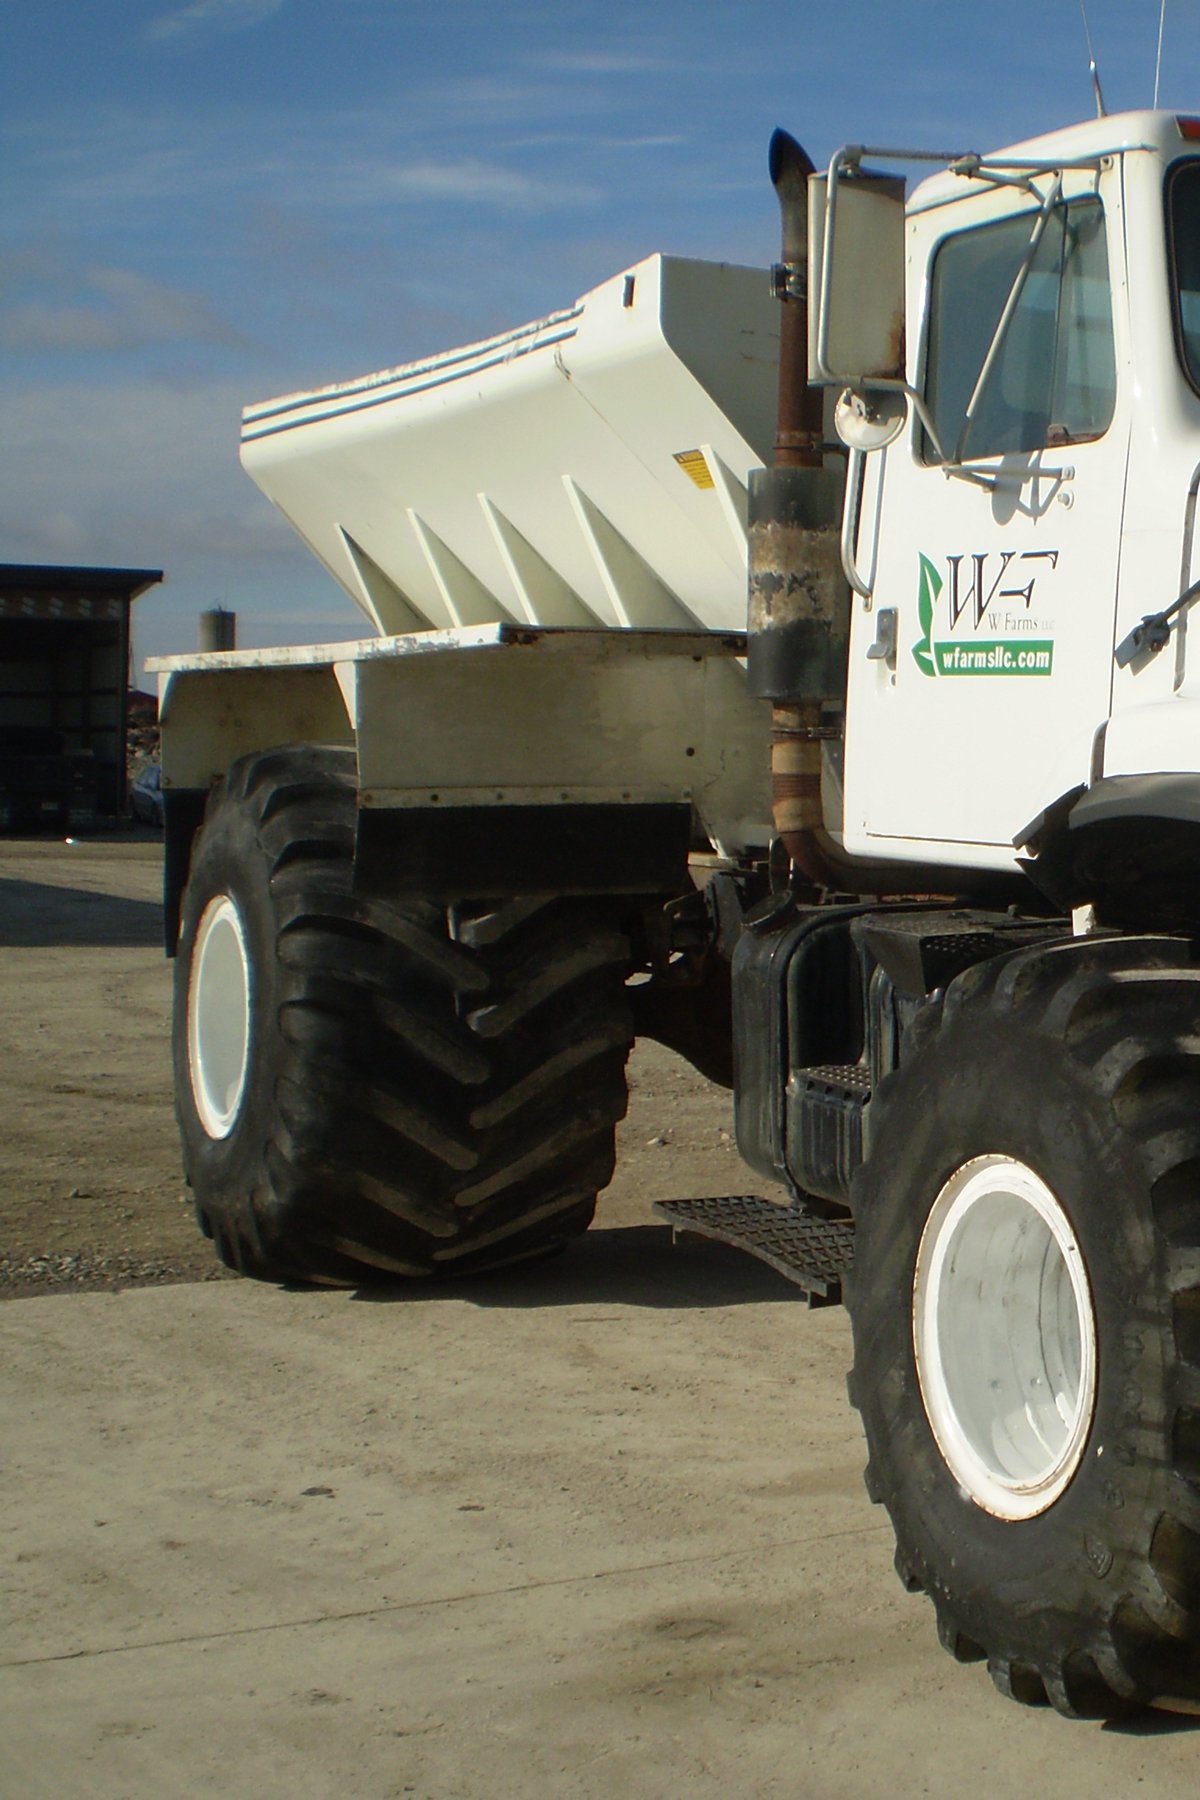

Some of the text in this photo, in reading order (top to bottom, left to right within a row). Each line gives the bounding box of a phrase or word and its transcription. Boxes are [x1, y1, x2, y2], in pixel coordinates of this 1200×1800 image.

[988, 612, 1001, 631] W
[1004, 612, 1038, 631] Farms
[943, 646, 1049, 668] wfarmsllc.com
